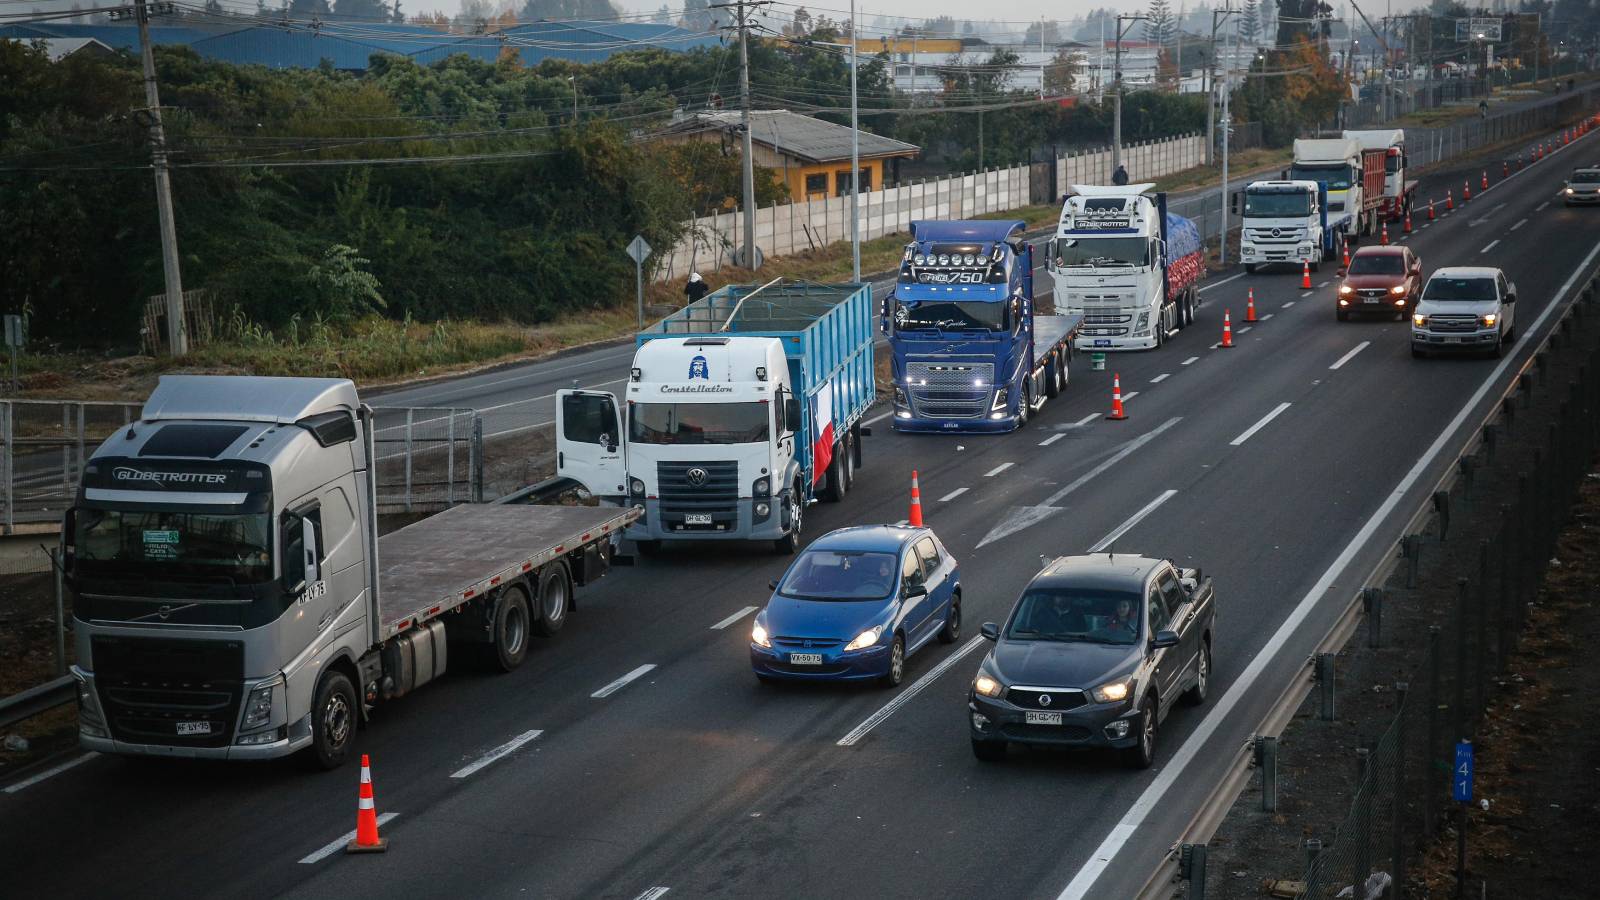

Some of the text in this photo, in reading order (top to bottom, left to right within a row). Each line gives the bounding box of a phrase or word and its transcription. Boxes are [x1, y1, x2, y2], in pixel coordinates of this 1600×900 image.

[948, 272, 983, 284] 750
[660, 384, 733, 394] Constellation
[117, 471, 227, 484] GLOBETROTTER
